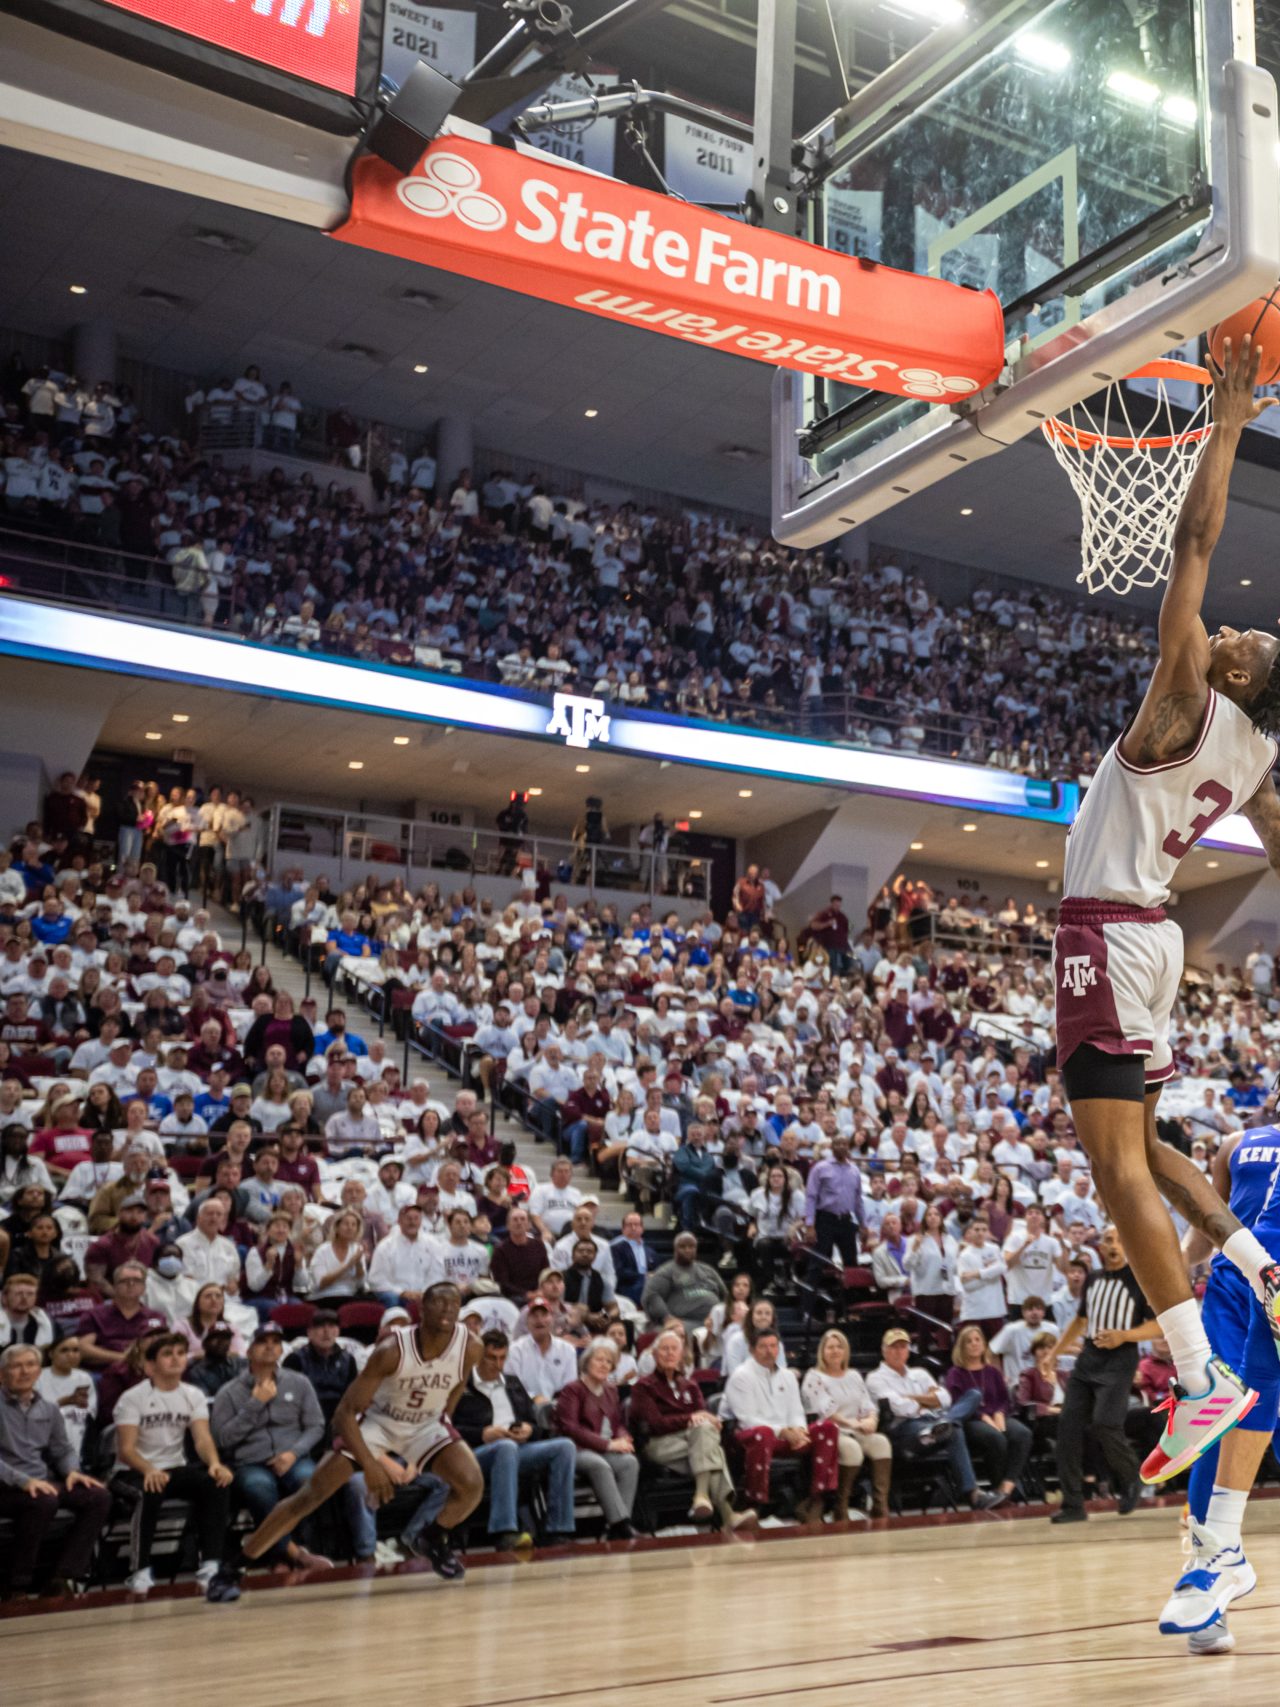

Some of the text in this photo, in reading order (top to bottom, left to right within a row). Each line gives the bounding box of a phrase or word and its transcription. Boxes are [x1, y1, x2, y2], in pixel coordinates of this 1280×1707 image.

[390, 3, 430, 26] SWEET
[392, 27, 438, 60] 2021
[696, 148, 735, 176] 2011
[1162, 779, 1233, 860] 3
[399, 1373, 452, 1391] TEXAS
[406, 1390, 428, 1409] 5
